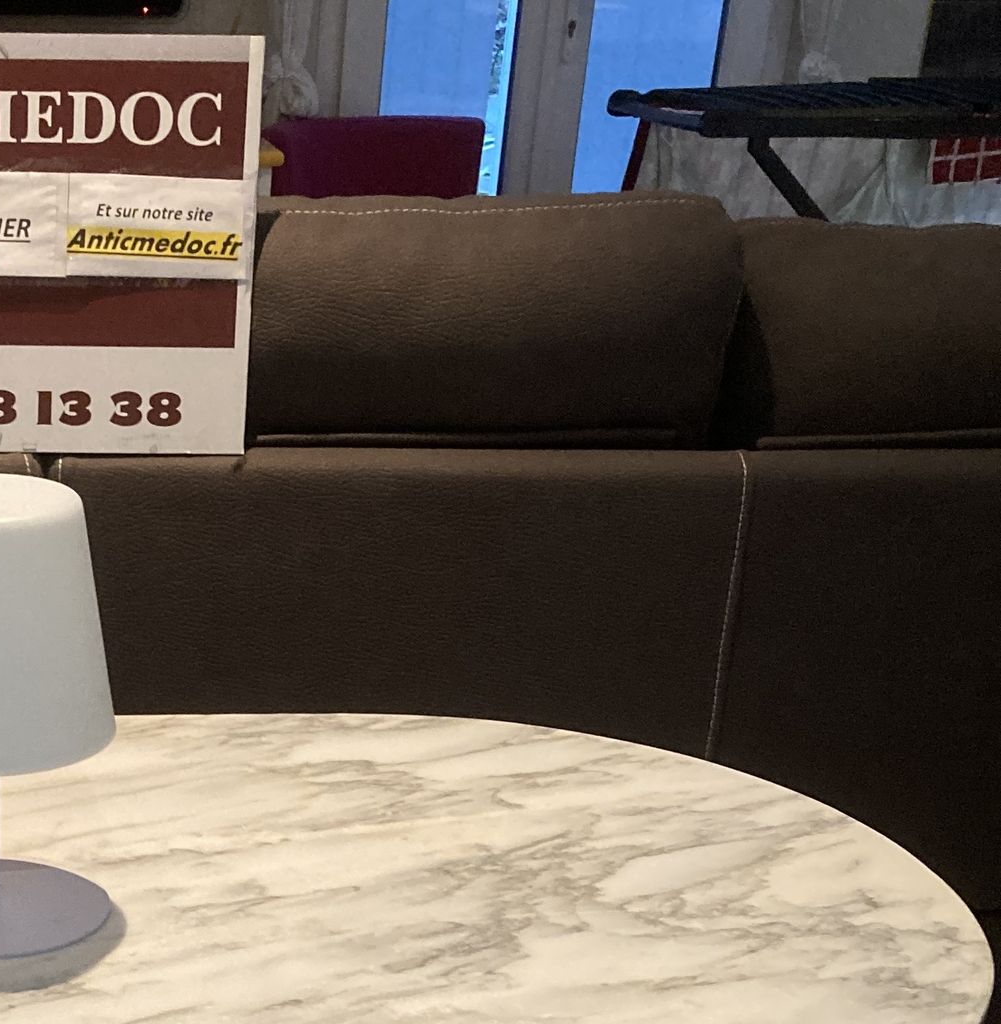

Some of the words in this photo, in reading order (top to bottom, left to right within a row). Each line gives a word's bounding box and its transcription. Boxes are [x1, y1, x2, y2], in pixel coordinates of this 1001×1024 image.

[96, 203, 112, 217] Et
[115, 207, 139, 218] sur
[142, 207, 183, 220] notre
[186, 206, 214, 222] site
[66, 228, 243, 256] Anticmedoc.fr
[36, 390, 92, 427] 13
[109, 390, 182, 427] 38
